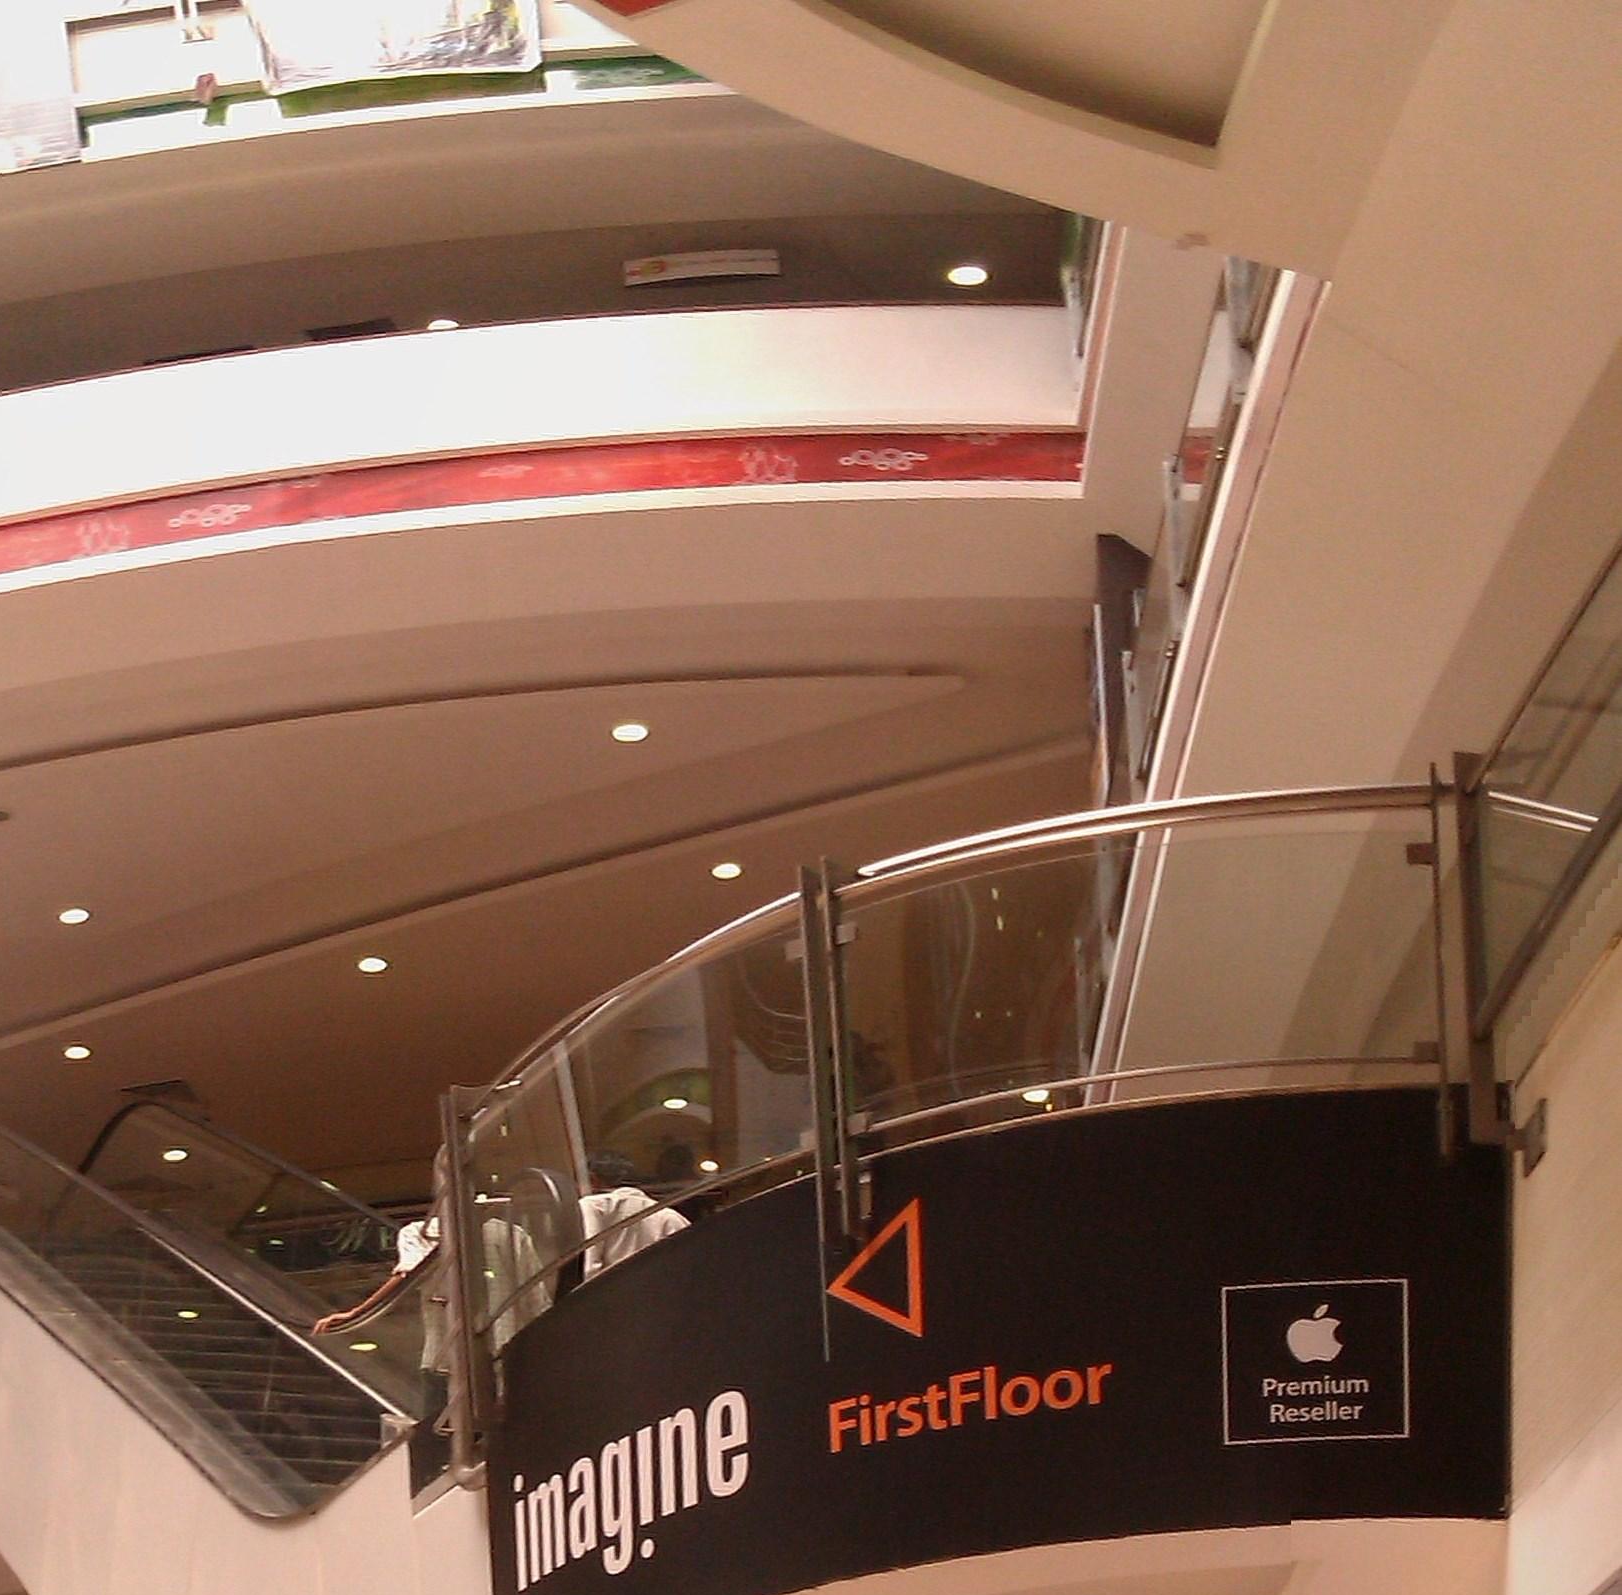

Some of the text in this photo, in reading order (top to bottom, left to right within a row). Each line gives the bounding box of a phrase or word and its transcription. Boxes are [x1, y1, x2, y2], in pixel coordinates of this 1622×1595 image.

[1263, 1376, 1370, 1397] Premium
[1270, 1401, 1364, 1423] Reseller
[514, 1390, 750, 1592] imagine
